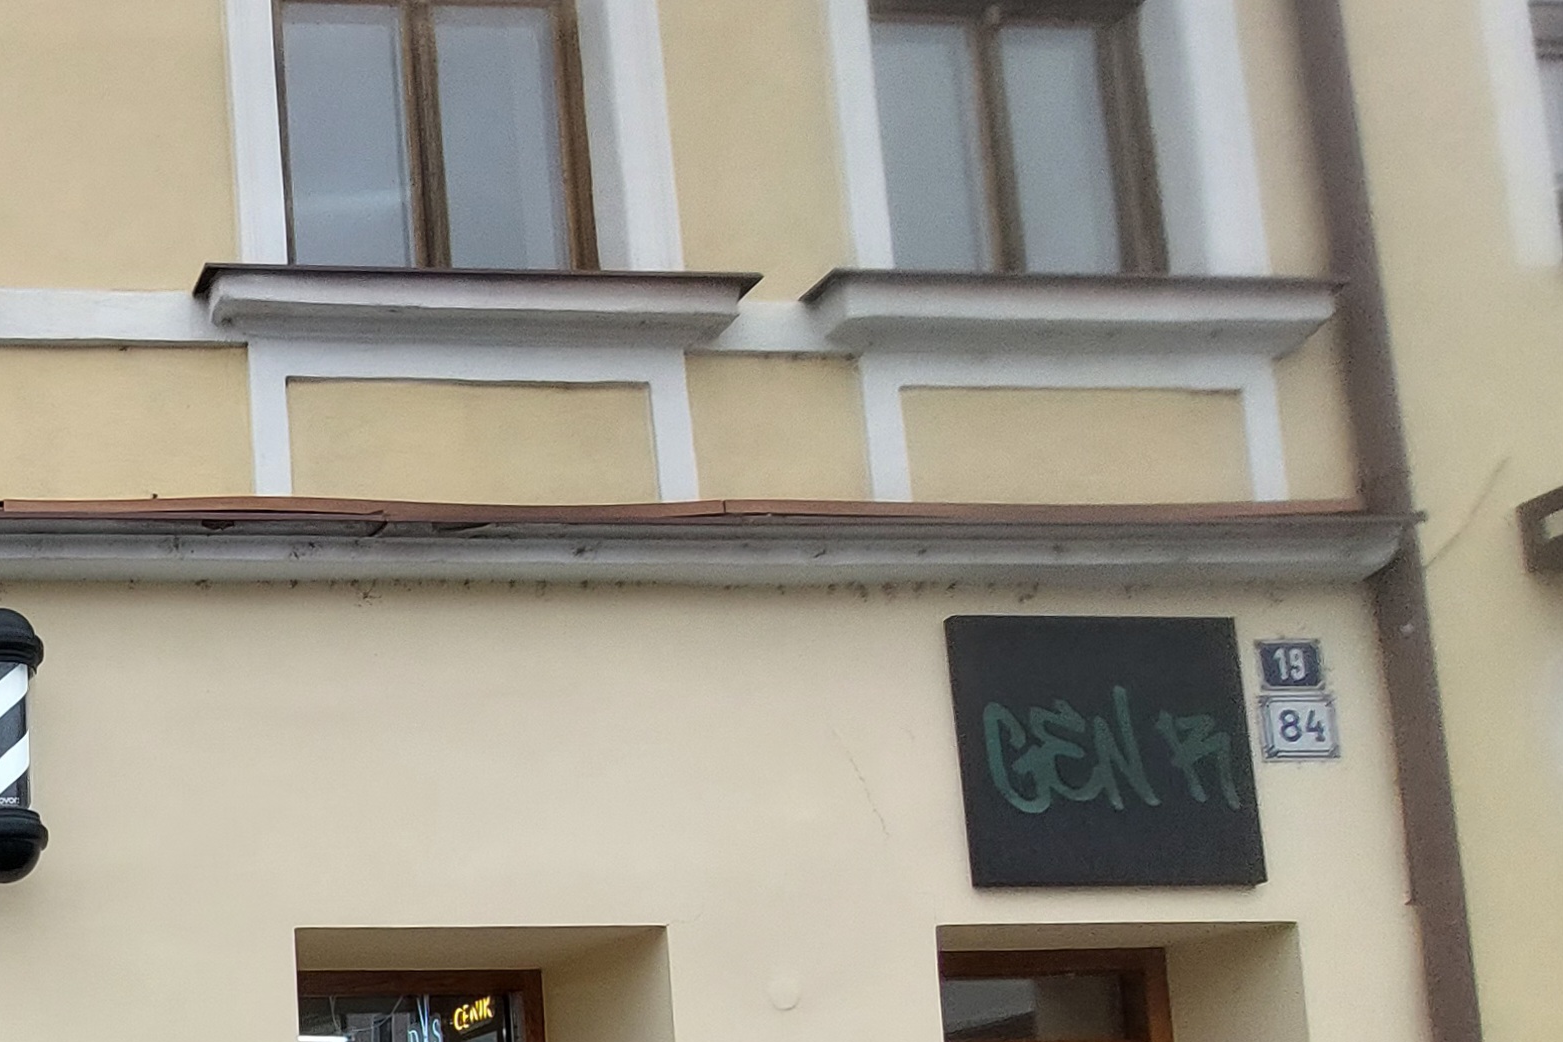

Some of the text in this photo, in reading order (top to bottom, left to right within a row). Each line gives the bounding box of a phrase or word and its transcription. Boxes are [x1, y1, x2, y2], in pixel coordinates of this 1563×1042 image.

[1272, 647, 1306, 682] 19
[1277, 708, 1326, 743] 84
[982, 685, 1239, 814] GEN R
